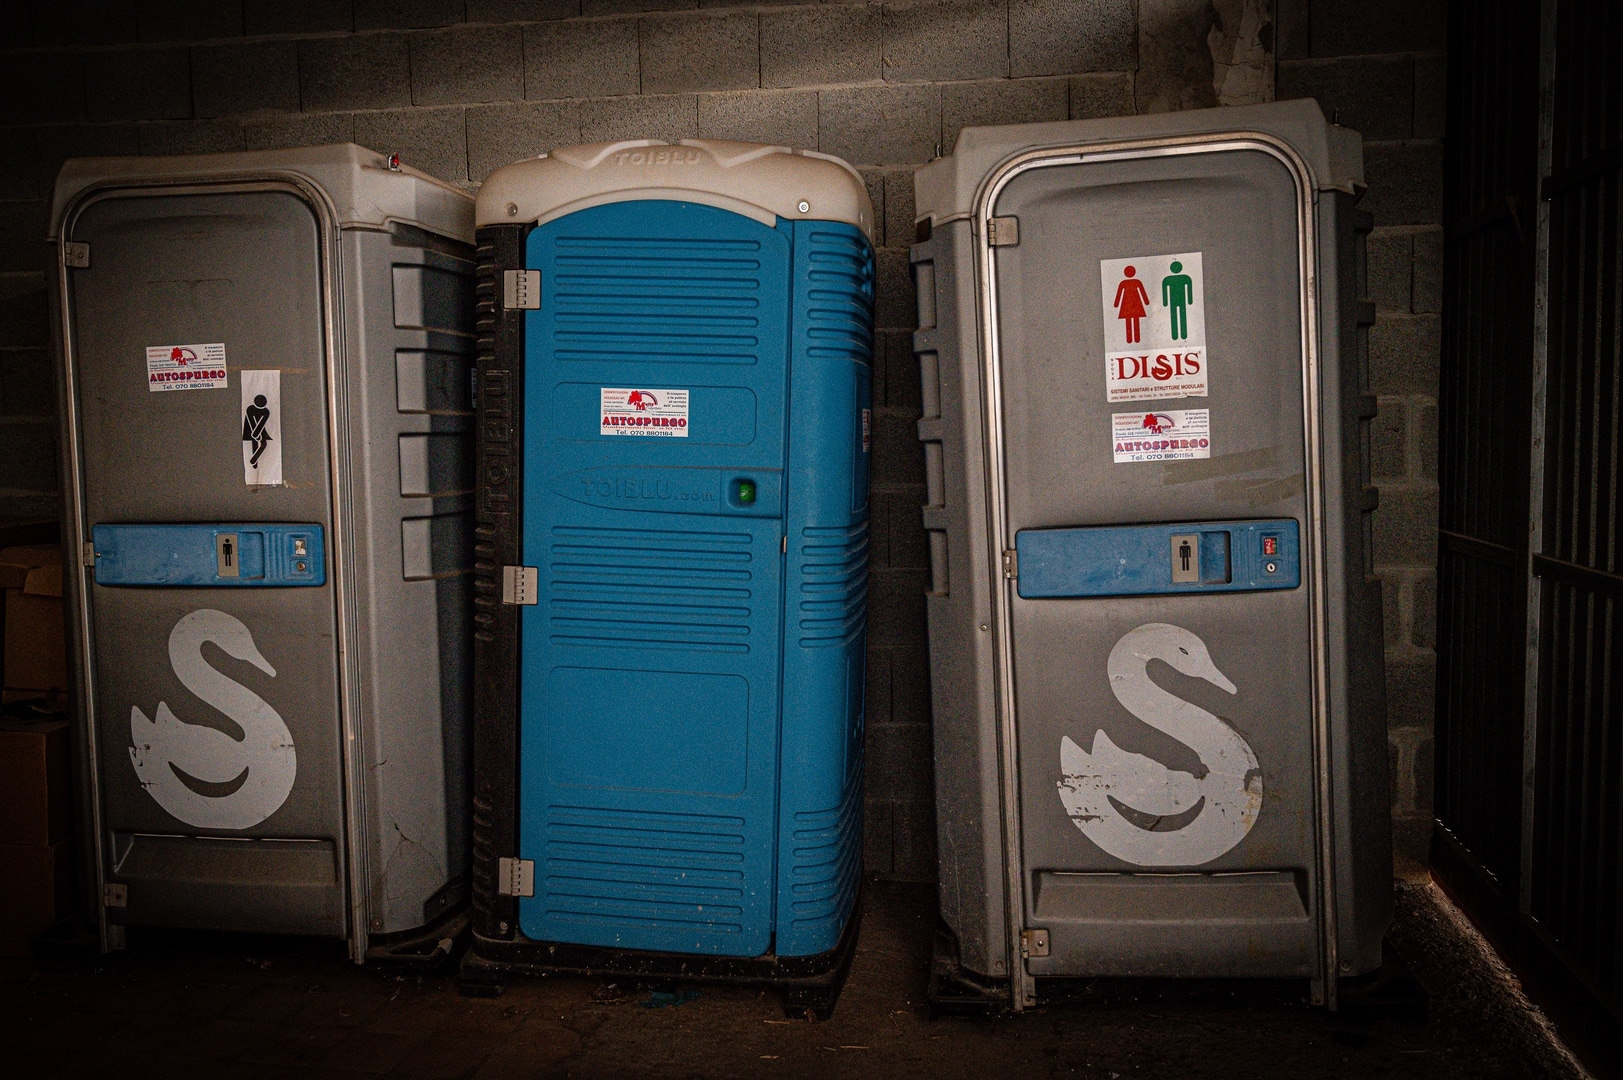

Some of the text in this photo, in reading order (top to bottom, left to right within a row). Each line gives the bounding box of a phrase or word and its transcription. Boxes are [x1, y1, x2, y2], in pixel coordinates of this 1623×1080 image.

[615, 151, 702, 166] TOIBLU
[1115, 352, 1201, 381] DISIS
[150, 369, 226, 383] AUTOSPURGO
[602, 416, 687, 427] AUTOSPURGO
[1115, 438, 1209, 452] AUTOSPURGO
[581, 477, 716, 502] TOIBLU.com
